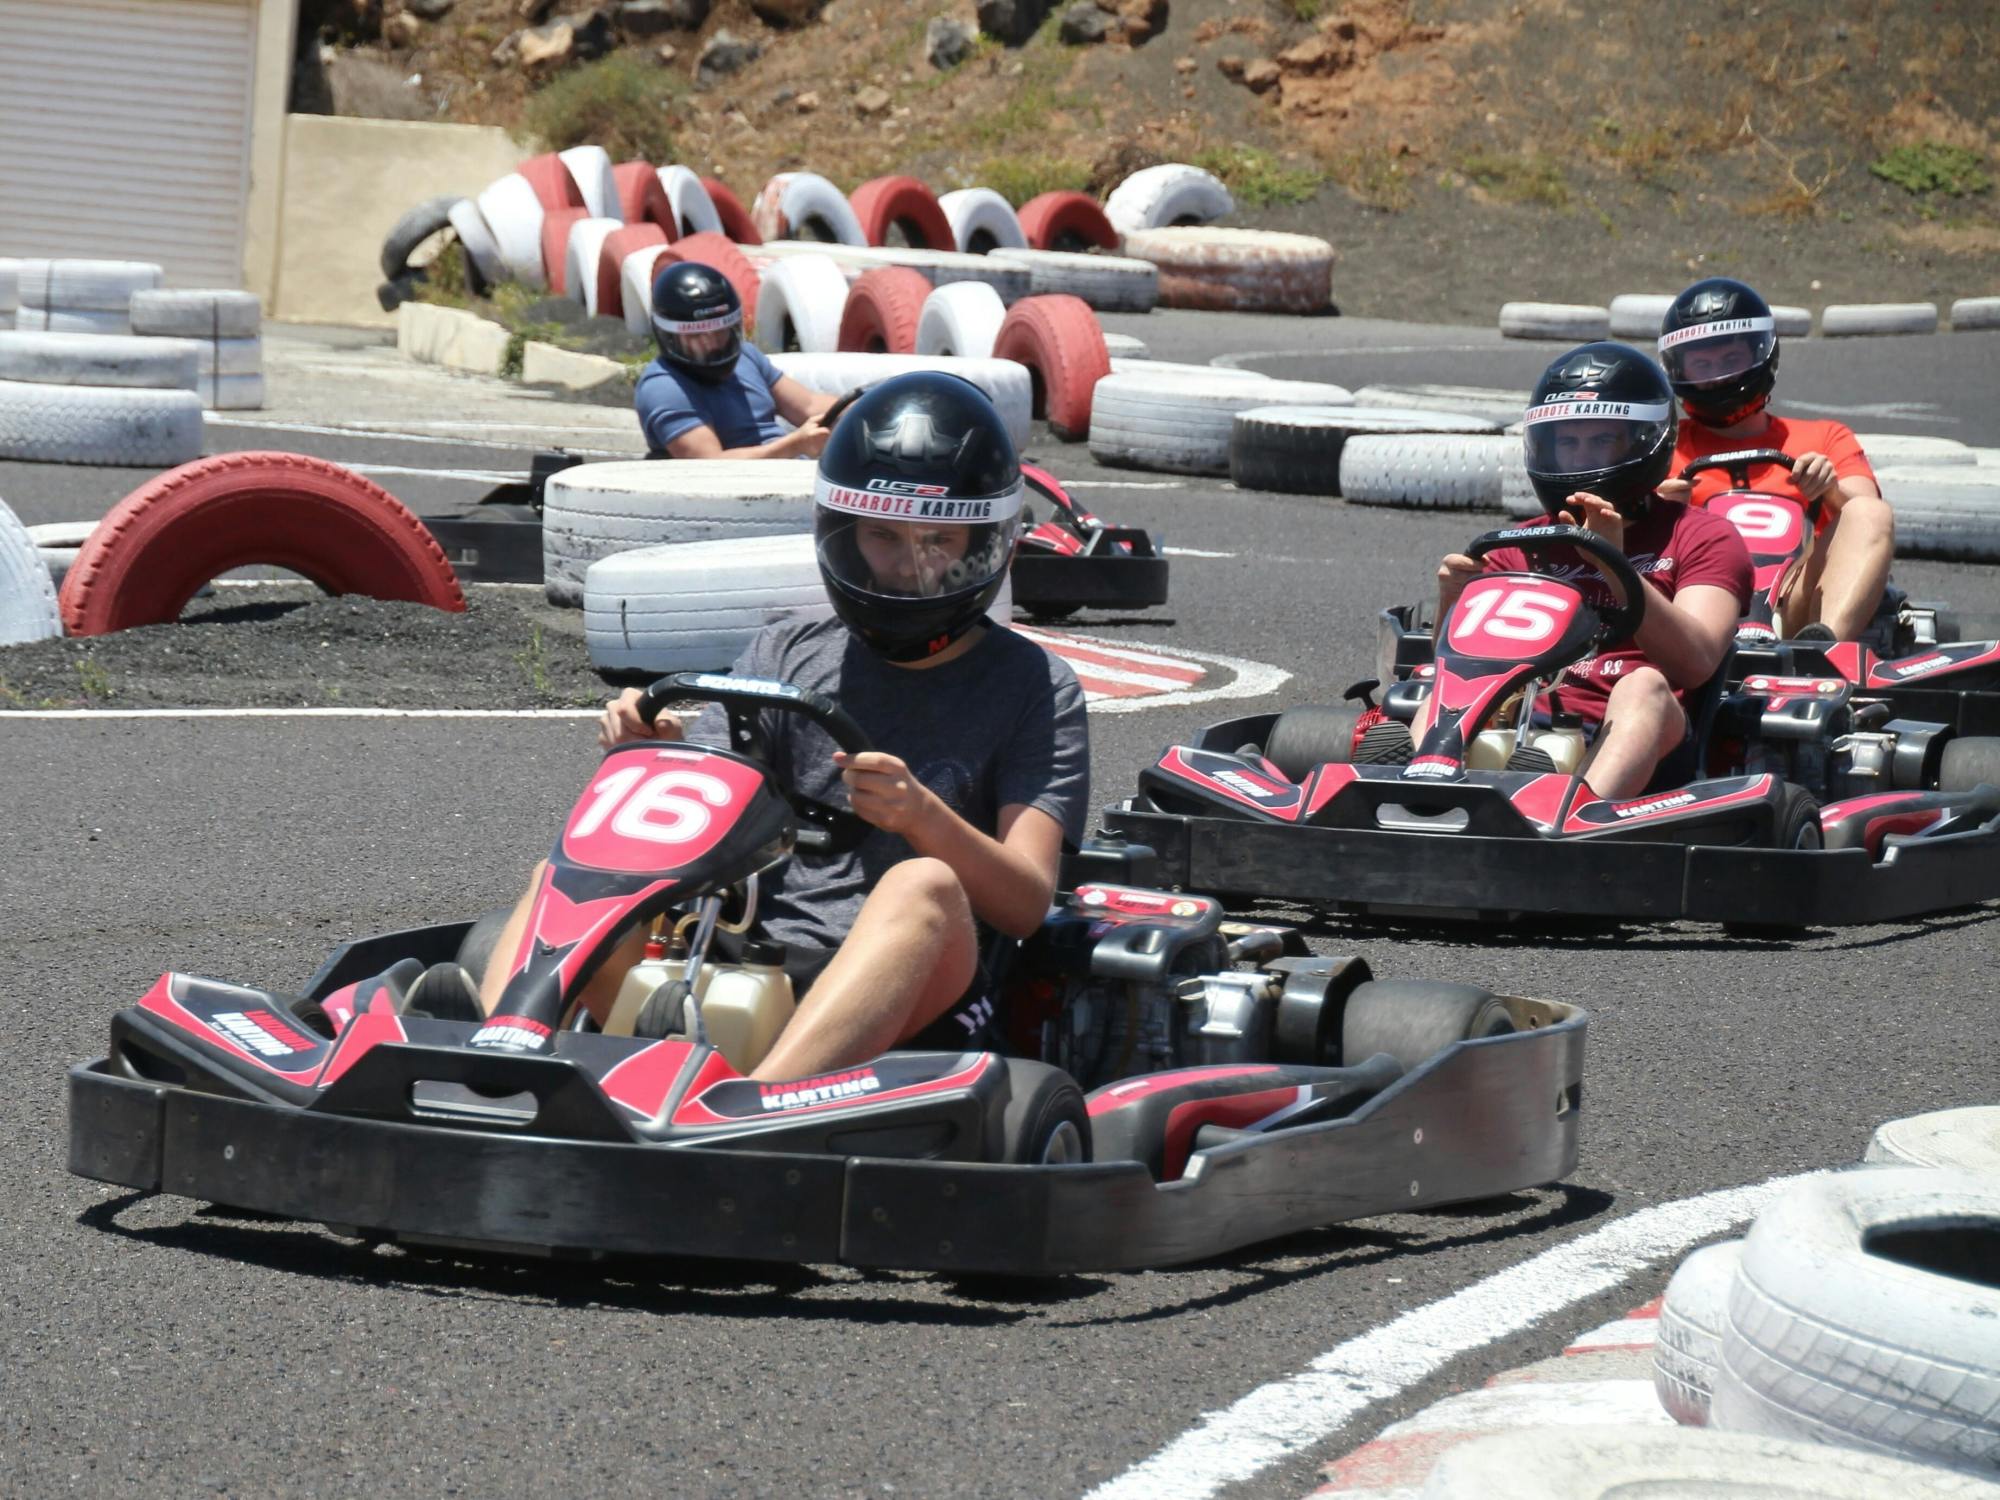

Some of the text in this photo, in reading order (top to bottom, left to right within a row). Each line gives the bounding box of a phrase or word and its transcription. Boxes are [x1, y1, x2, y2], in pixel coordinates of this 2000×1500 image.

[1712, 319, 1753, 332] KARTING
[1544, 391, 1600, 403] LS2
[1575, 403, 1630, 415] KARTING
[866, 478, 950, 497] LS2
[828, 487, 992, 518] LANZAROTE KARTING
[1498, 526, 1556, 539] BIZKARTS
[1726, 502, 1792, 539] 9
[1453, 588, 1569, 641] 15
[1403, 762, 1457, 776] KARTING
[569, 766, 733, 844] 16
[1616, 794, 1697, 818] KARTING
[211, 1012, 295, 1057] KARTING
[470, 1026, 547, 1050] KARTING
[761, 1076, 880, 1110] KARTING
